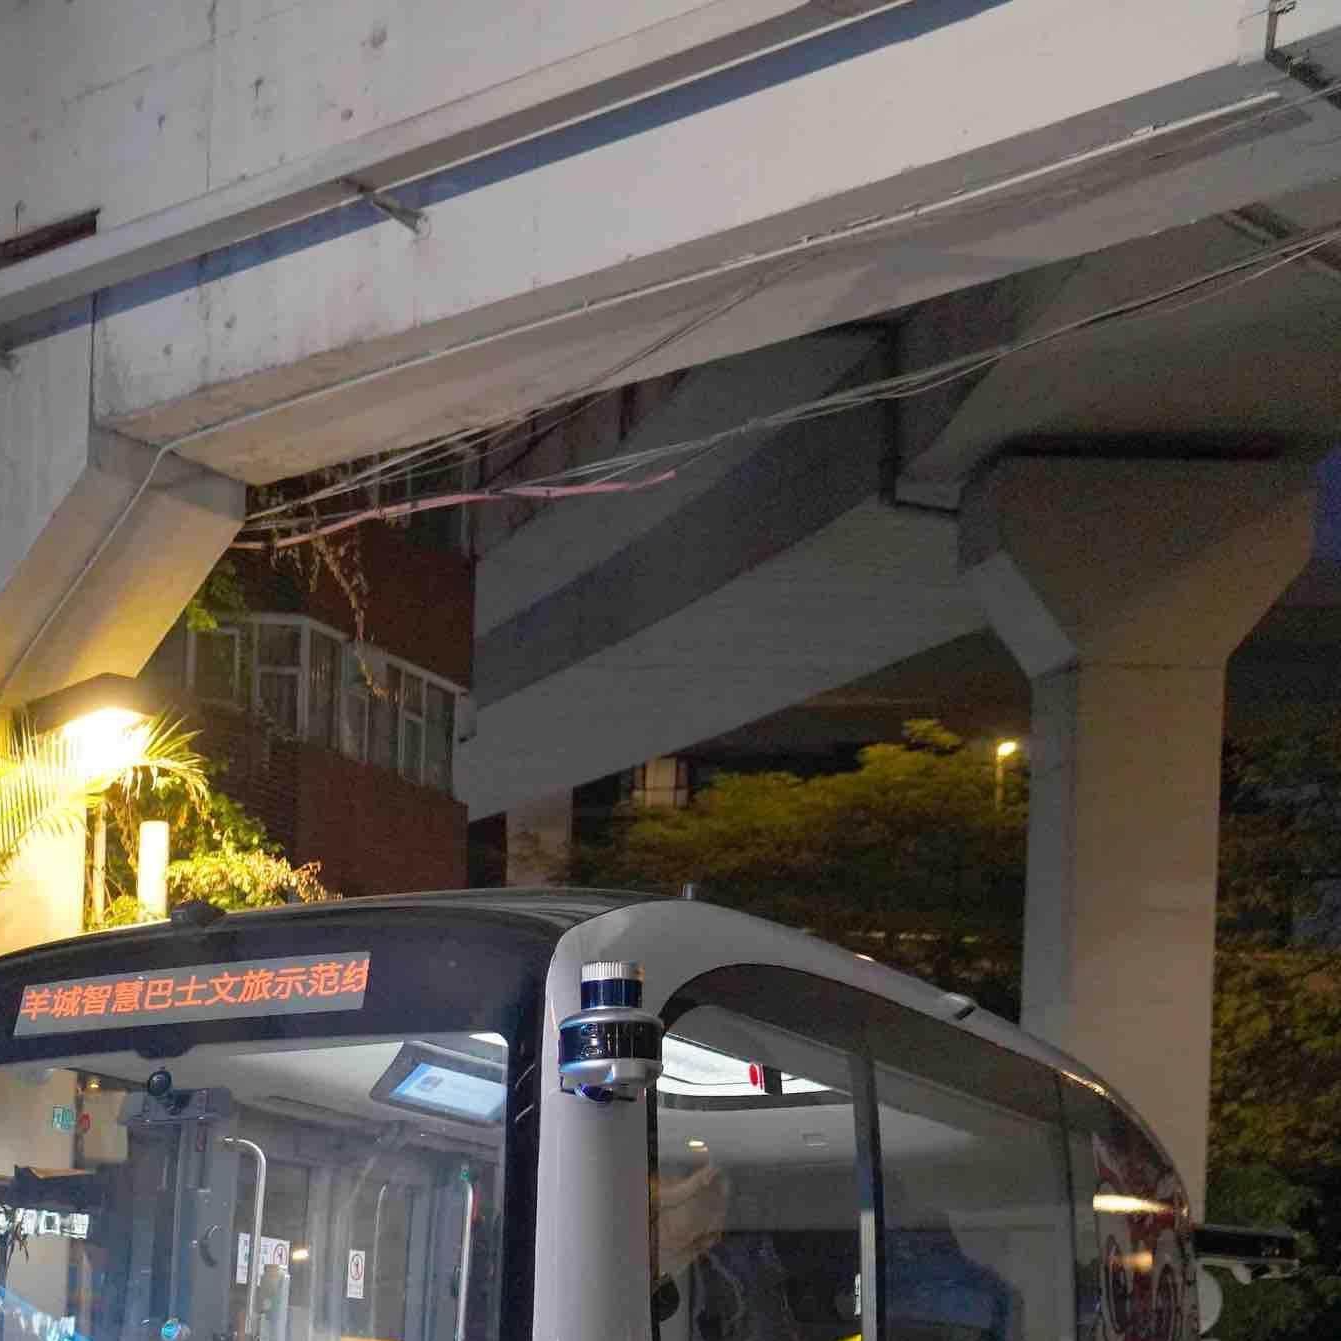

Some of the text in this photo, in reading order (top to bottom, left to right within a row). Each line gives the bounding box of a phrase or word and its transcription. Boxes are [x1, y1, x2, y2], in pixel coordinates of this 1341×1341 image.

[21, 960, 370, 1021] 羊城智慧巴士文旅示范线
